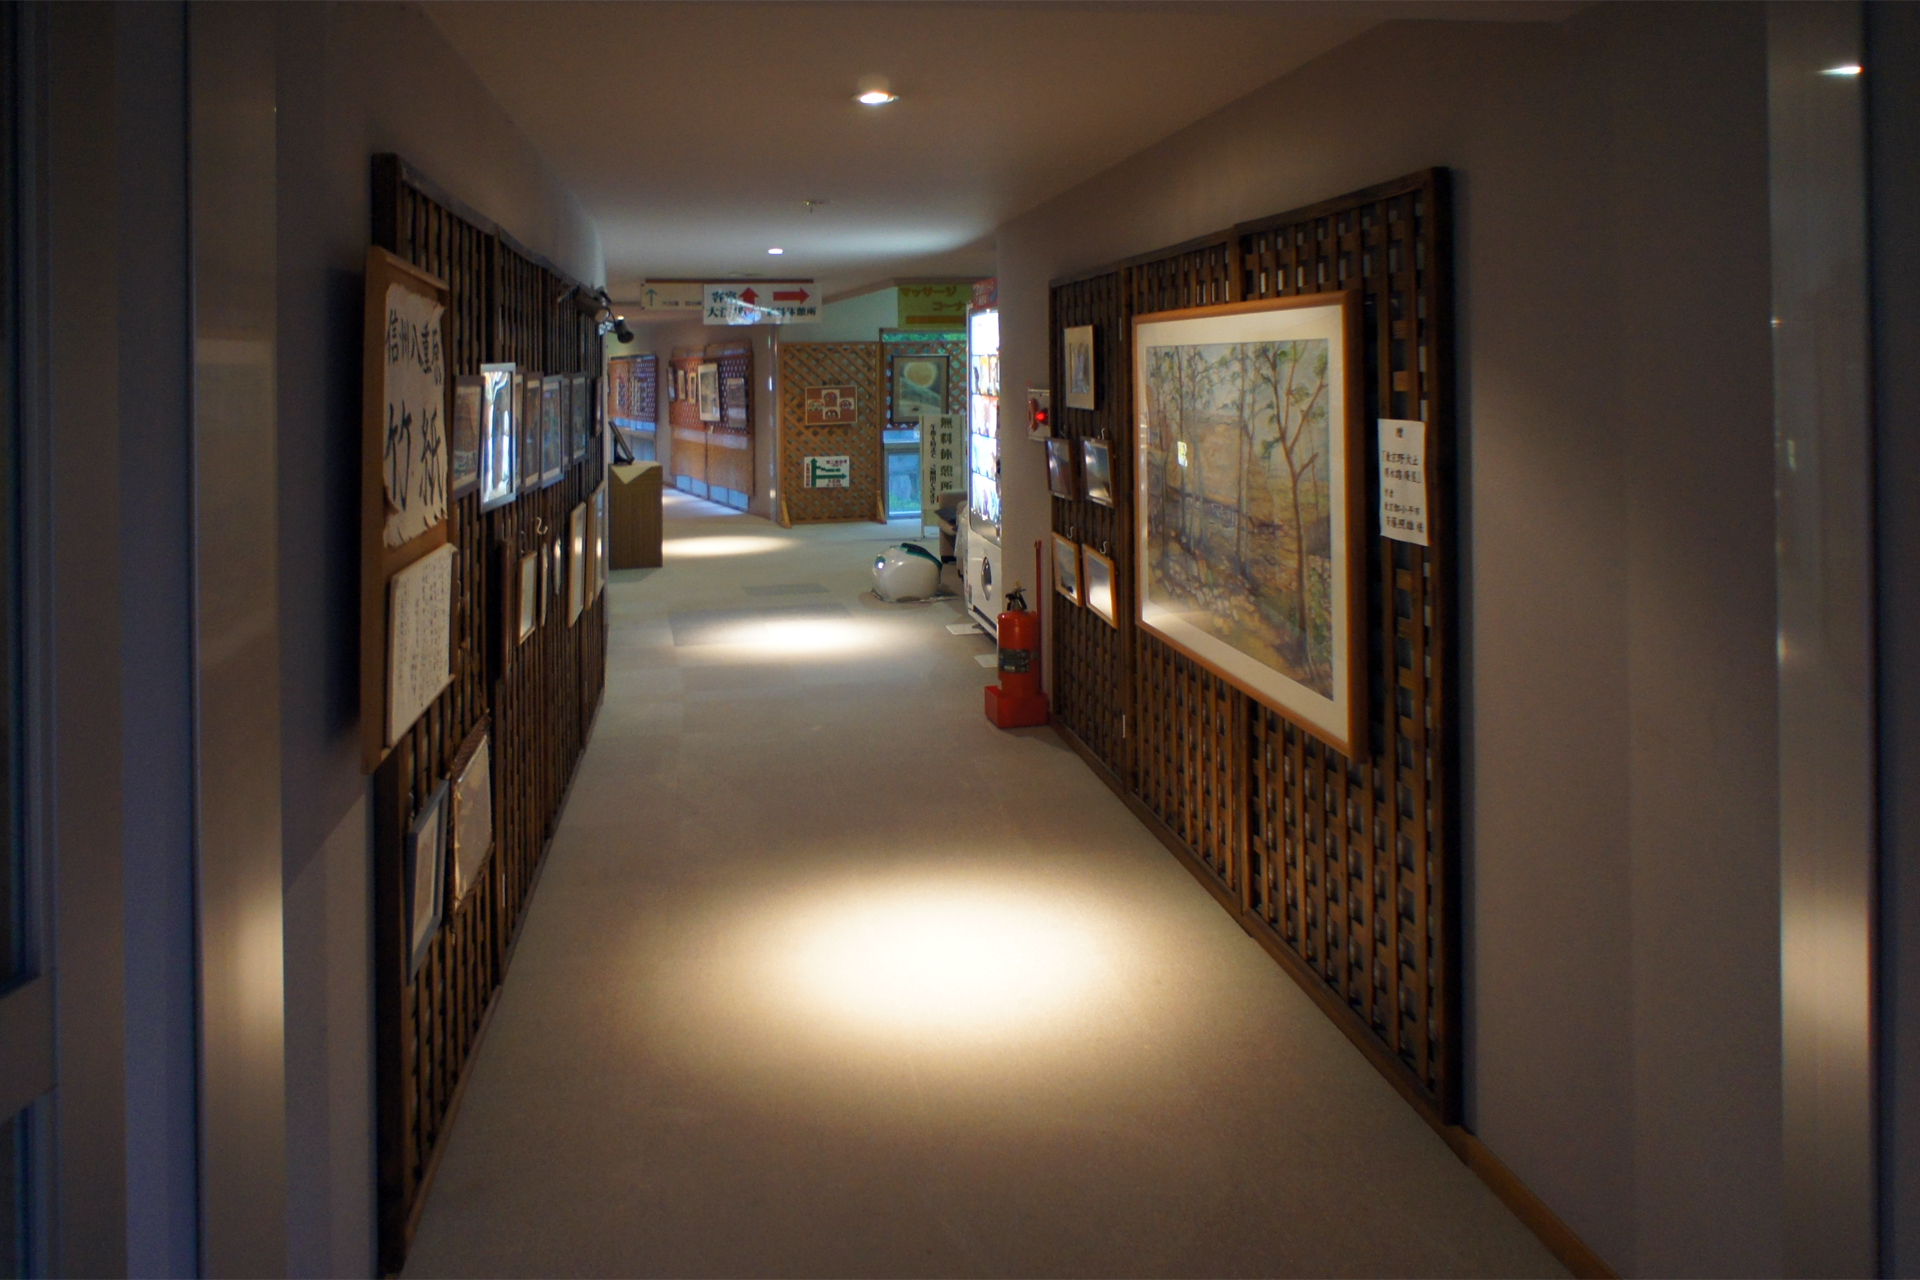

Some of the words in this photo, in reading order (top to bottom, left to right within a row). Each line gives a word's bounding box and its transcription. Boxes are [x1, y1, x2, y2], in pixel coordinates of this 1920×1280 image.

[900, 285, 957, 298] マッサージ
[932, 301, 966, 312] コーナ
[385, 400, 443, 512] 竹紙
[940, 417, 953, 491] 無料休憩所
